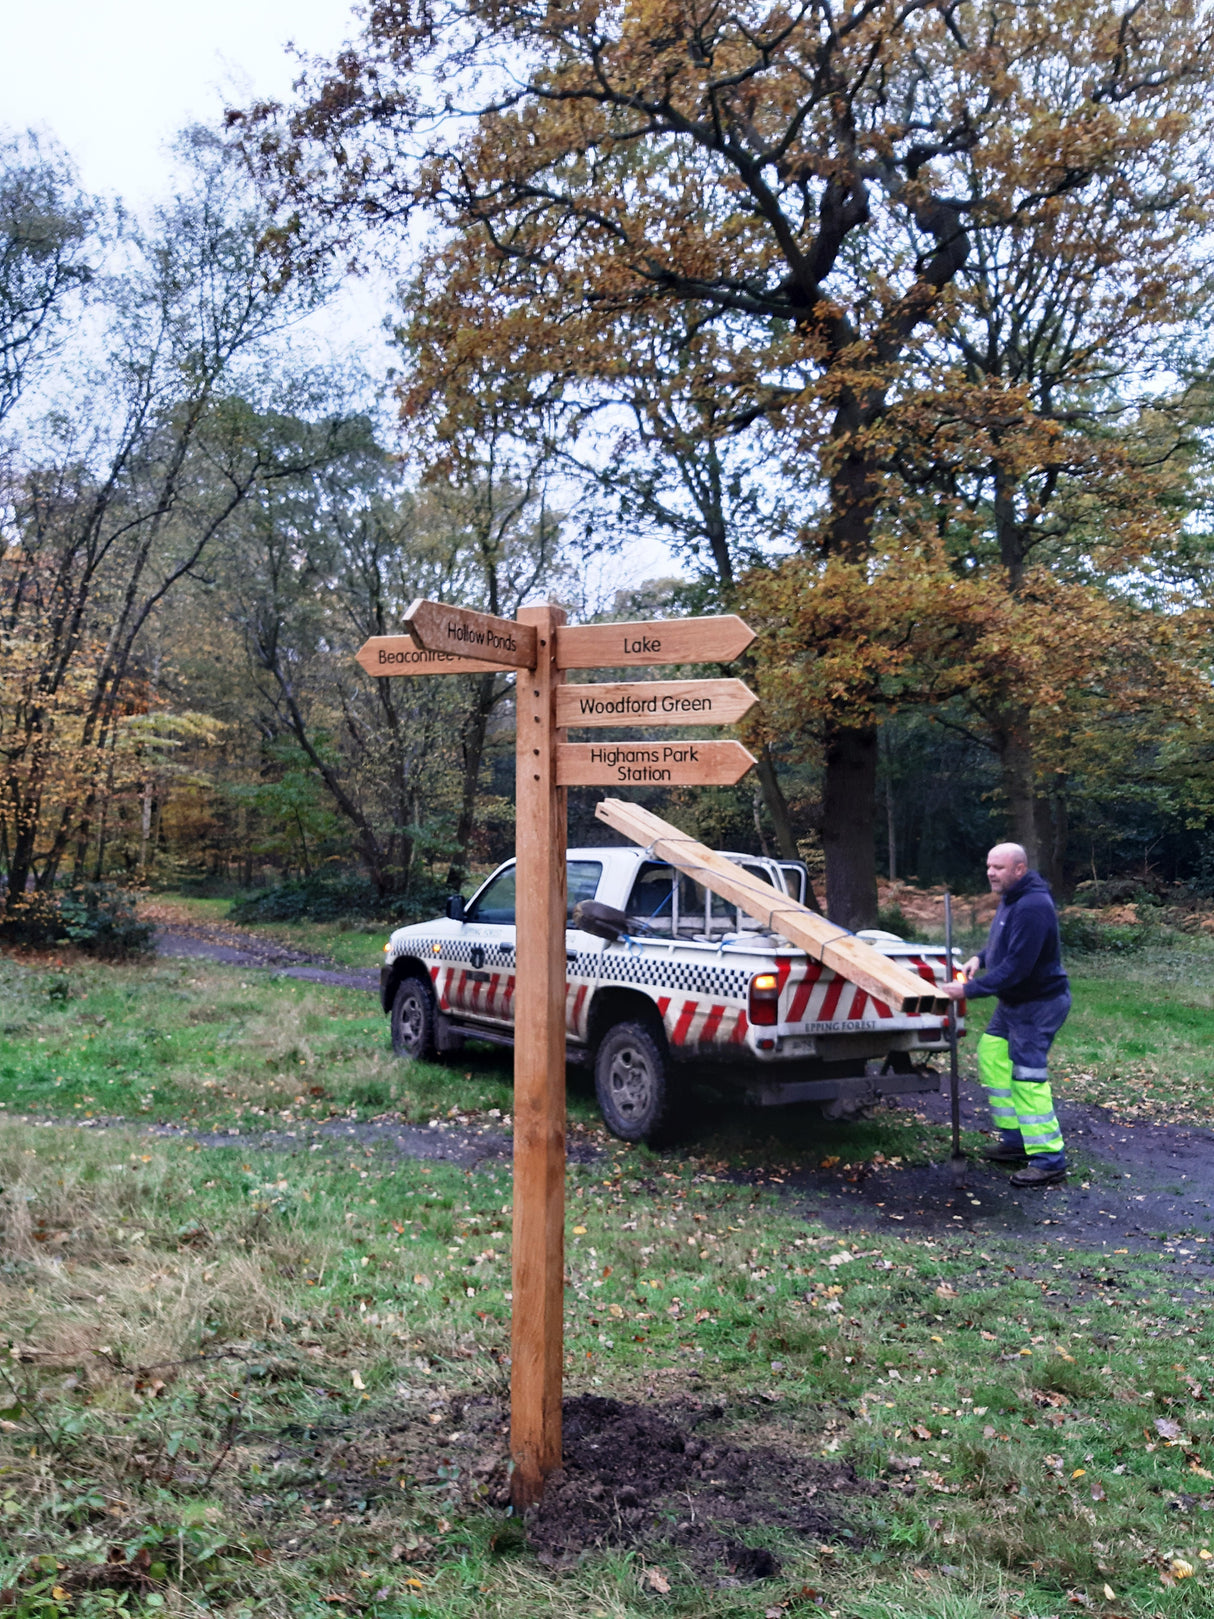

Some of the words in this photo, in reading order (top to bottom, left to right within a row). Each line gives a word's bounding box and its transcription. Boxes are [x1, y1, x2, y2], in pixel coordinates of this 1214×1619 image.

[447, 622, 485, 644] Hollow
[487, 630, 516, 652] Ponds
[624, 635, 661, 654] Lake
[580, 696, 656, 714] Woodford
[661, 696, 712, 712] Green
[591, 747, 659, 766] Highams
[663, 746, 699, 762] Park
[618, 766, 671, 781] Station
[805, 1022, 840, 1032] EPPING
[842, 1020, 876, 1031] FOREST
